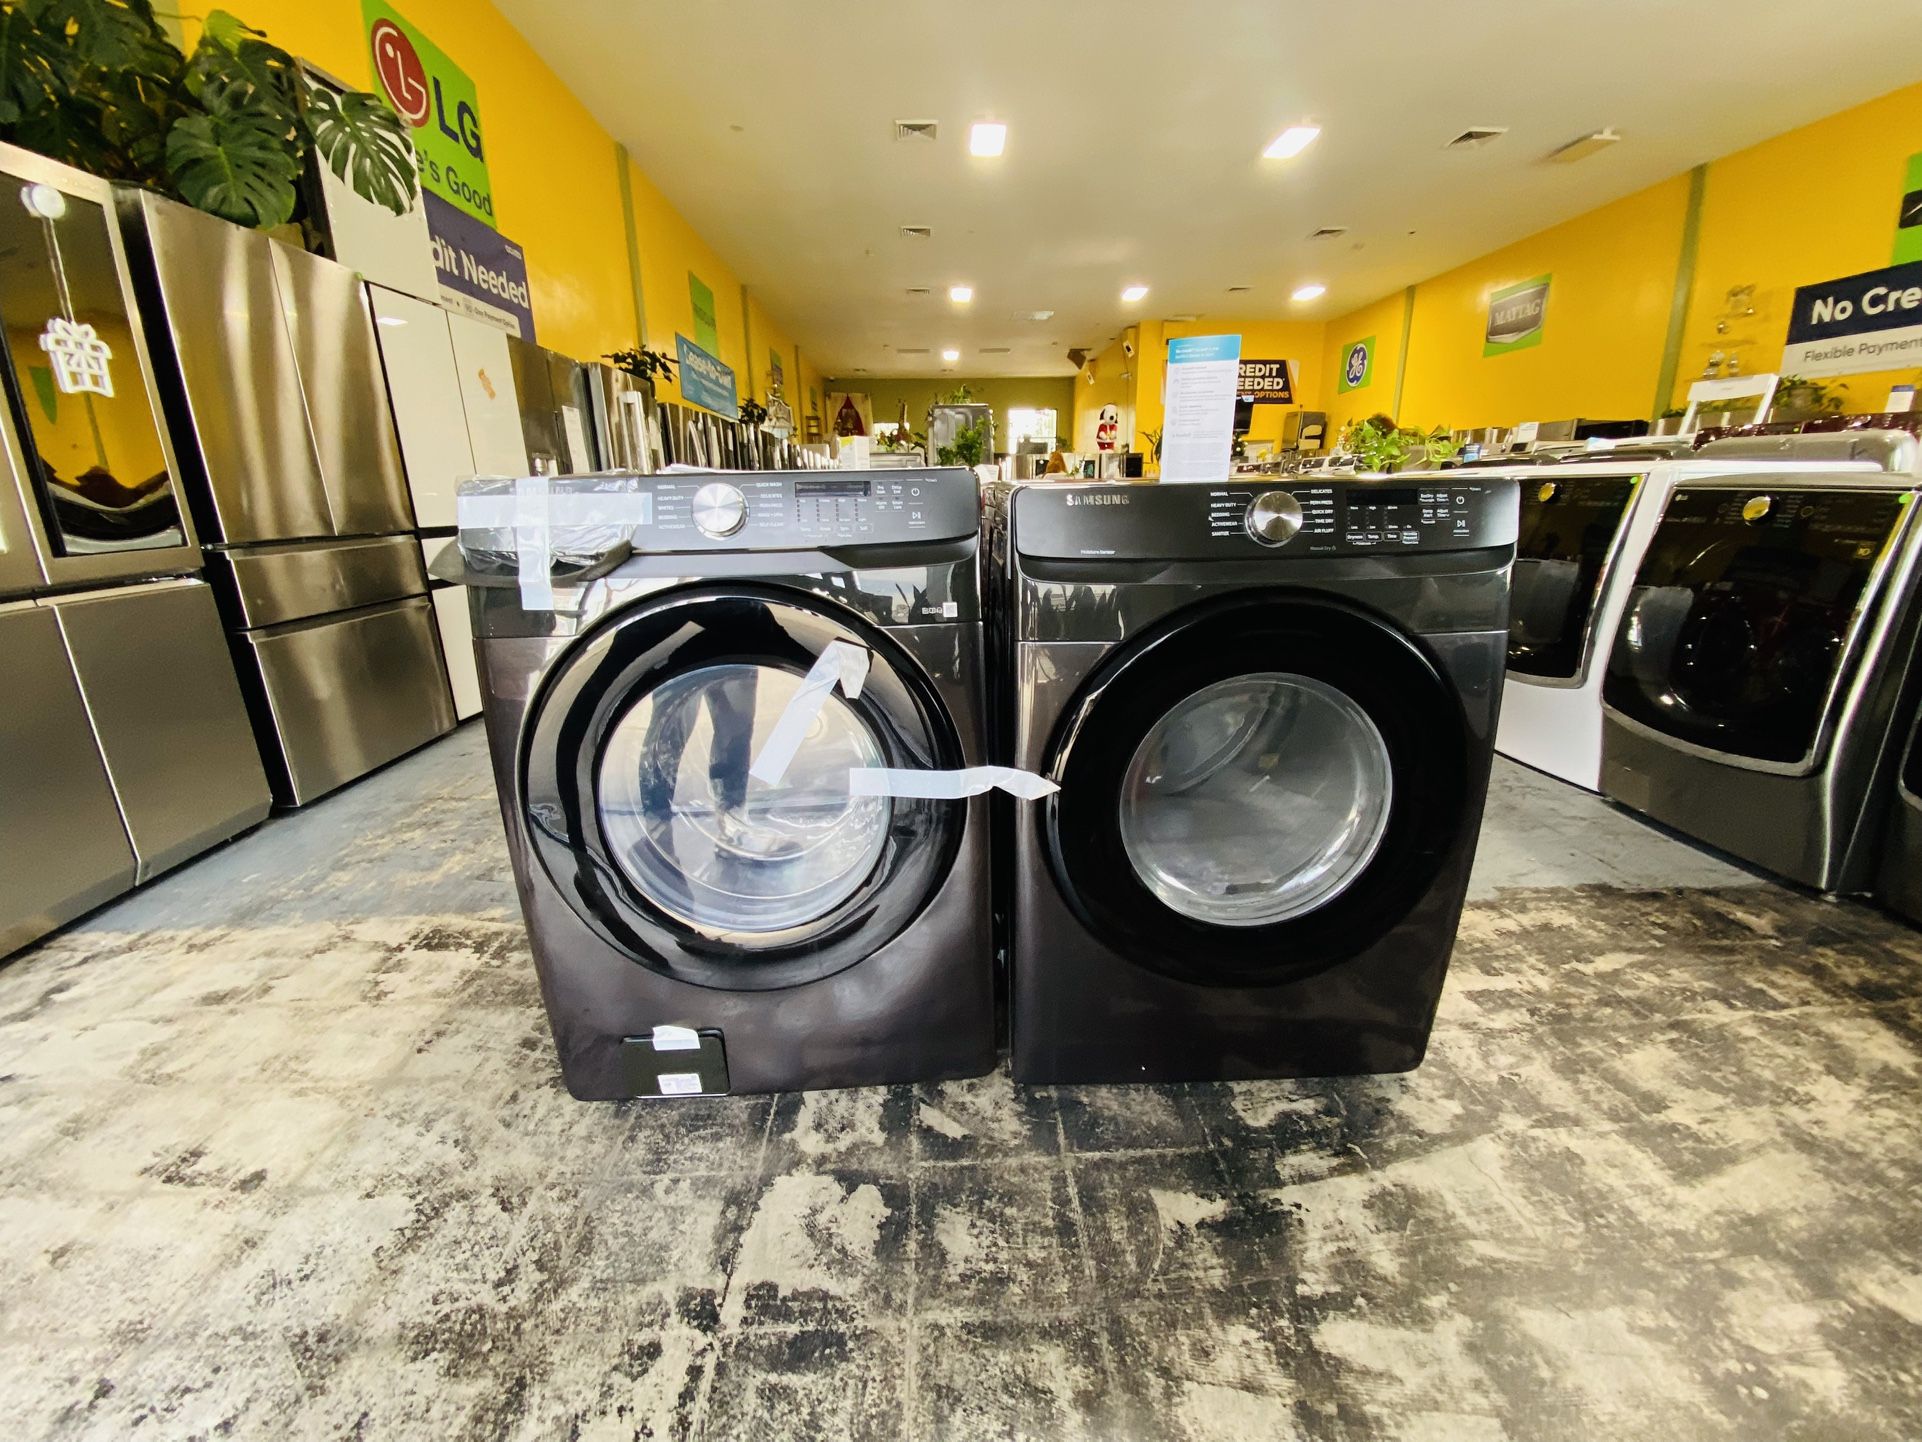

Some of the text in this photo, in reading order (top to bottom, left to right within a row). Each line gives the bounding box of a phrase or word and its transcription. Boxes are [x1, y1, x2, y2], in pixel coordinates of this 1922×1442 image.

[432, 76, 484, 163] LG
[445, 165, 493, 217] Good
[460, 249, 530, 309] Needed
[1495, 299, 1541, 326] MAYTAG
[1810, 286, 1922, 325] No Cre
[1803, 345, 1855, 362] Flexible
[1239, 364, 1280, 377] REDIT
[1066, 494, 1130, 506] SAMSUNG
